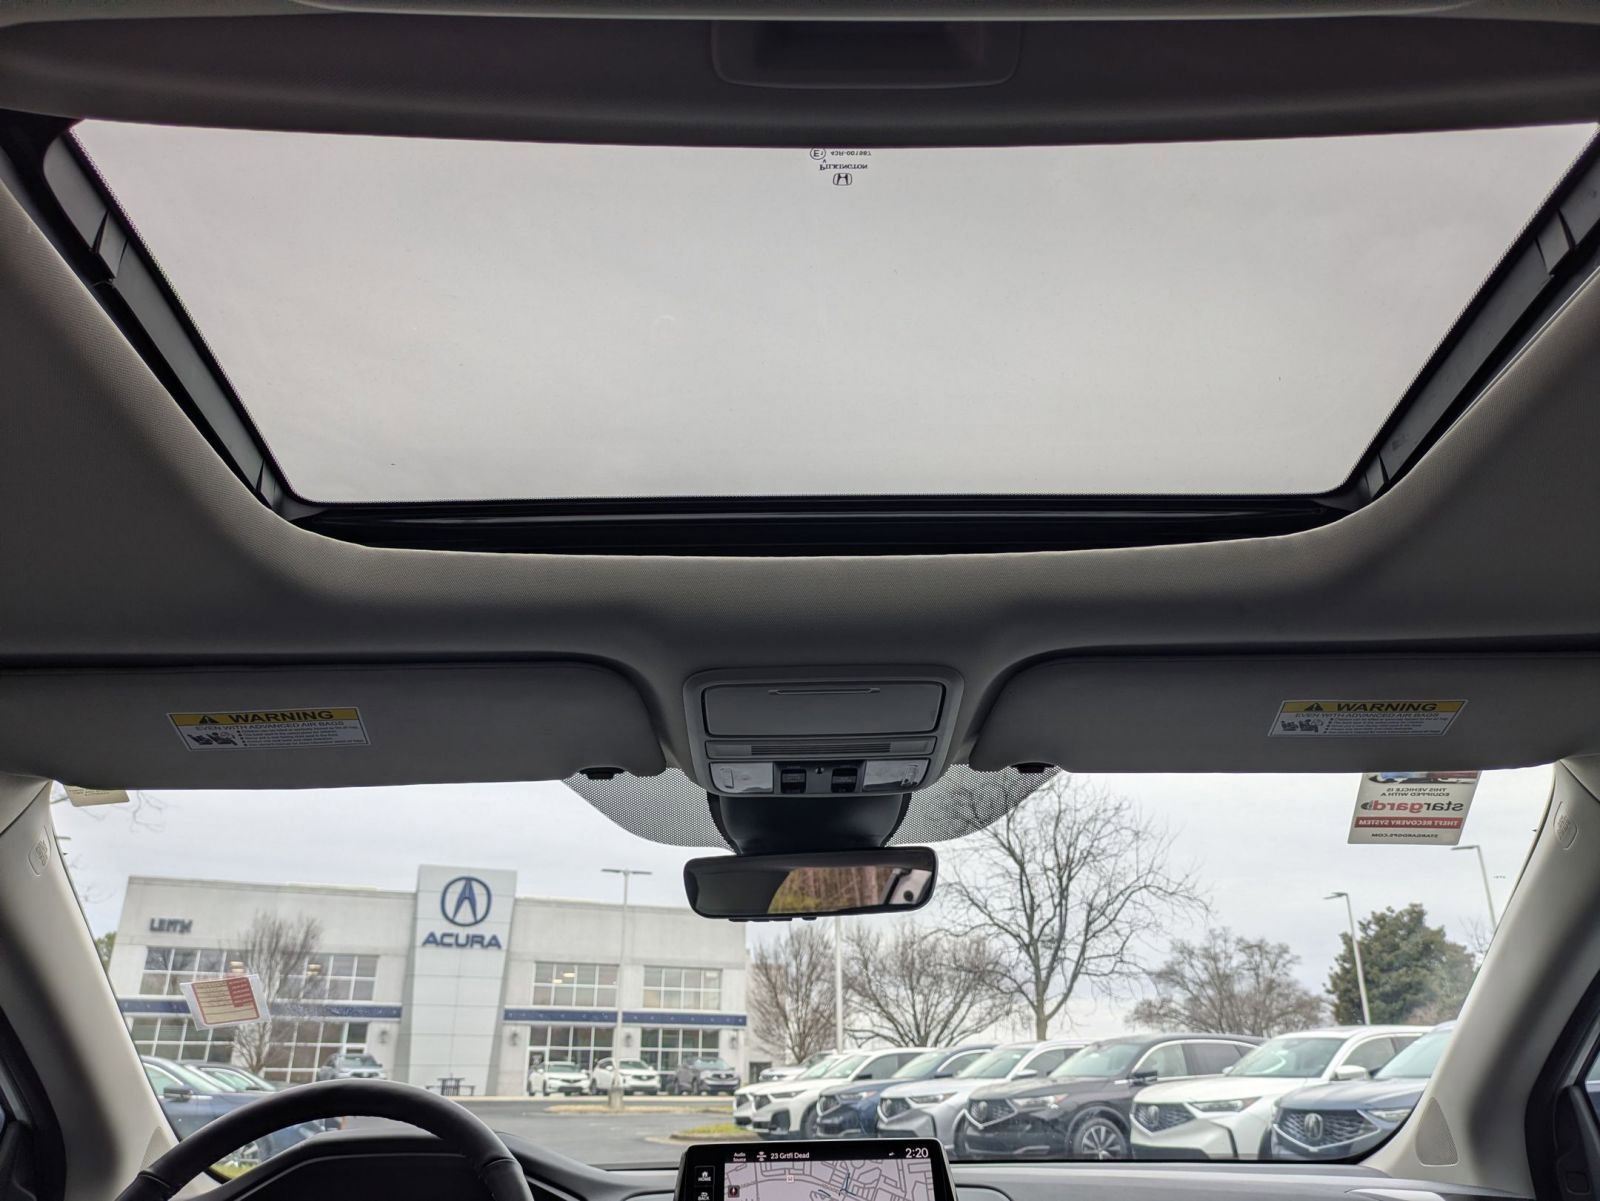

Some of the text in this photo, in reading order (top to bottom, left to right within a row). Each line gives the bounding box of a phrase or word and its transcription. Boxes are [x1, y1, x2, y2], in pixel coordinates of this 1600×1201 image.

[1337, 702, 1438, 712] WARNING
[228, 709, 334, 723] WARNING
[421, 930, 503, 950] ACURA
[770, 1152, 779, 1160] 23
[905, 1147, 929, 1159] 2:20
